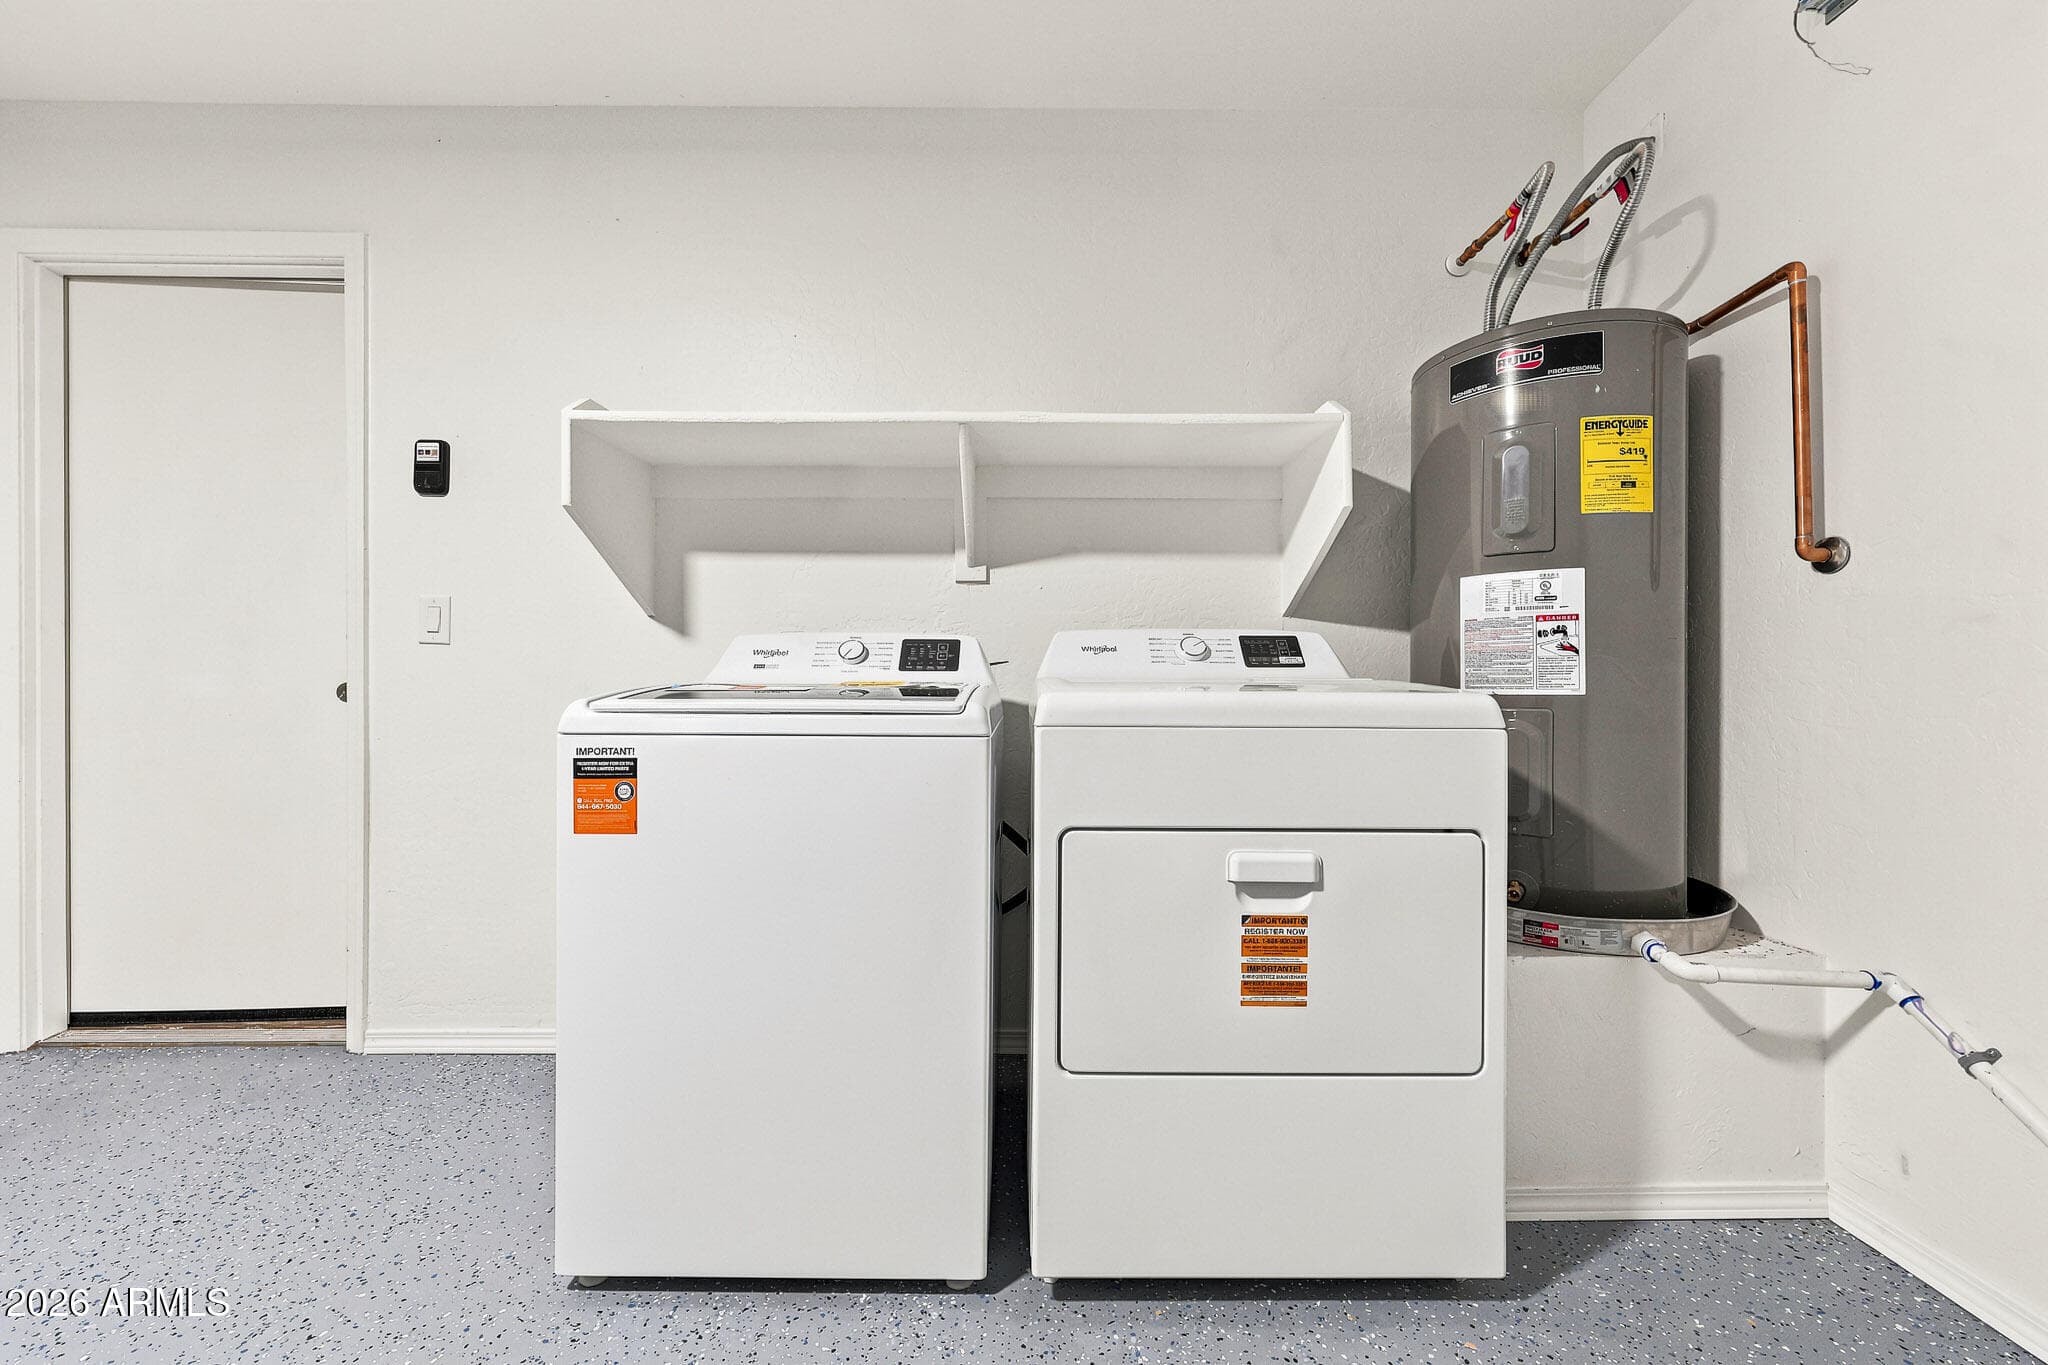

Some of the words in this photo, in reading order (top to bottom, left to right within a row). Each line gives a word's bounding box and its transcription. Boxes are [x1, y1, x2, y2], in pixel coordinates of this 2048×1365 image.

[1619, 447, 1645, 456] $419
[752, 649, 790, 658] Whirlpool
[1080, 645, 1118, 655] Whirlpool
[576, 747, 635, 756] IMPORTANT!
